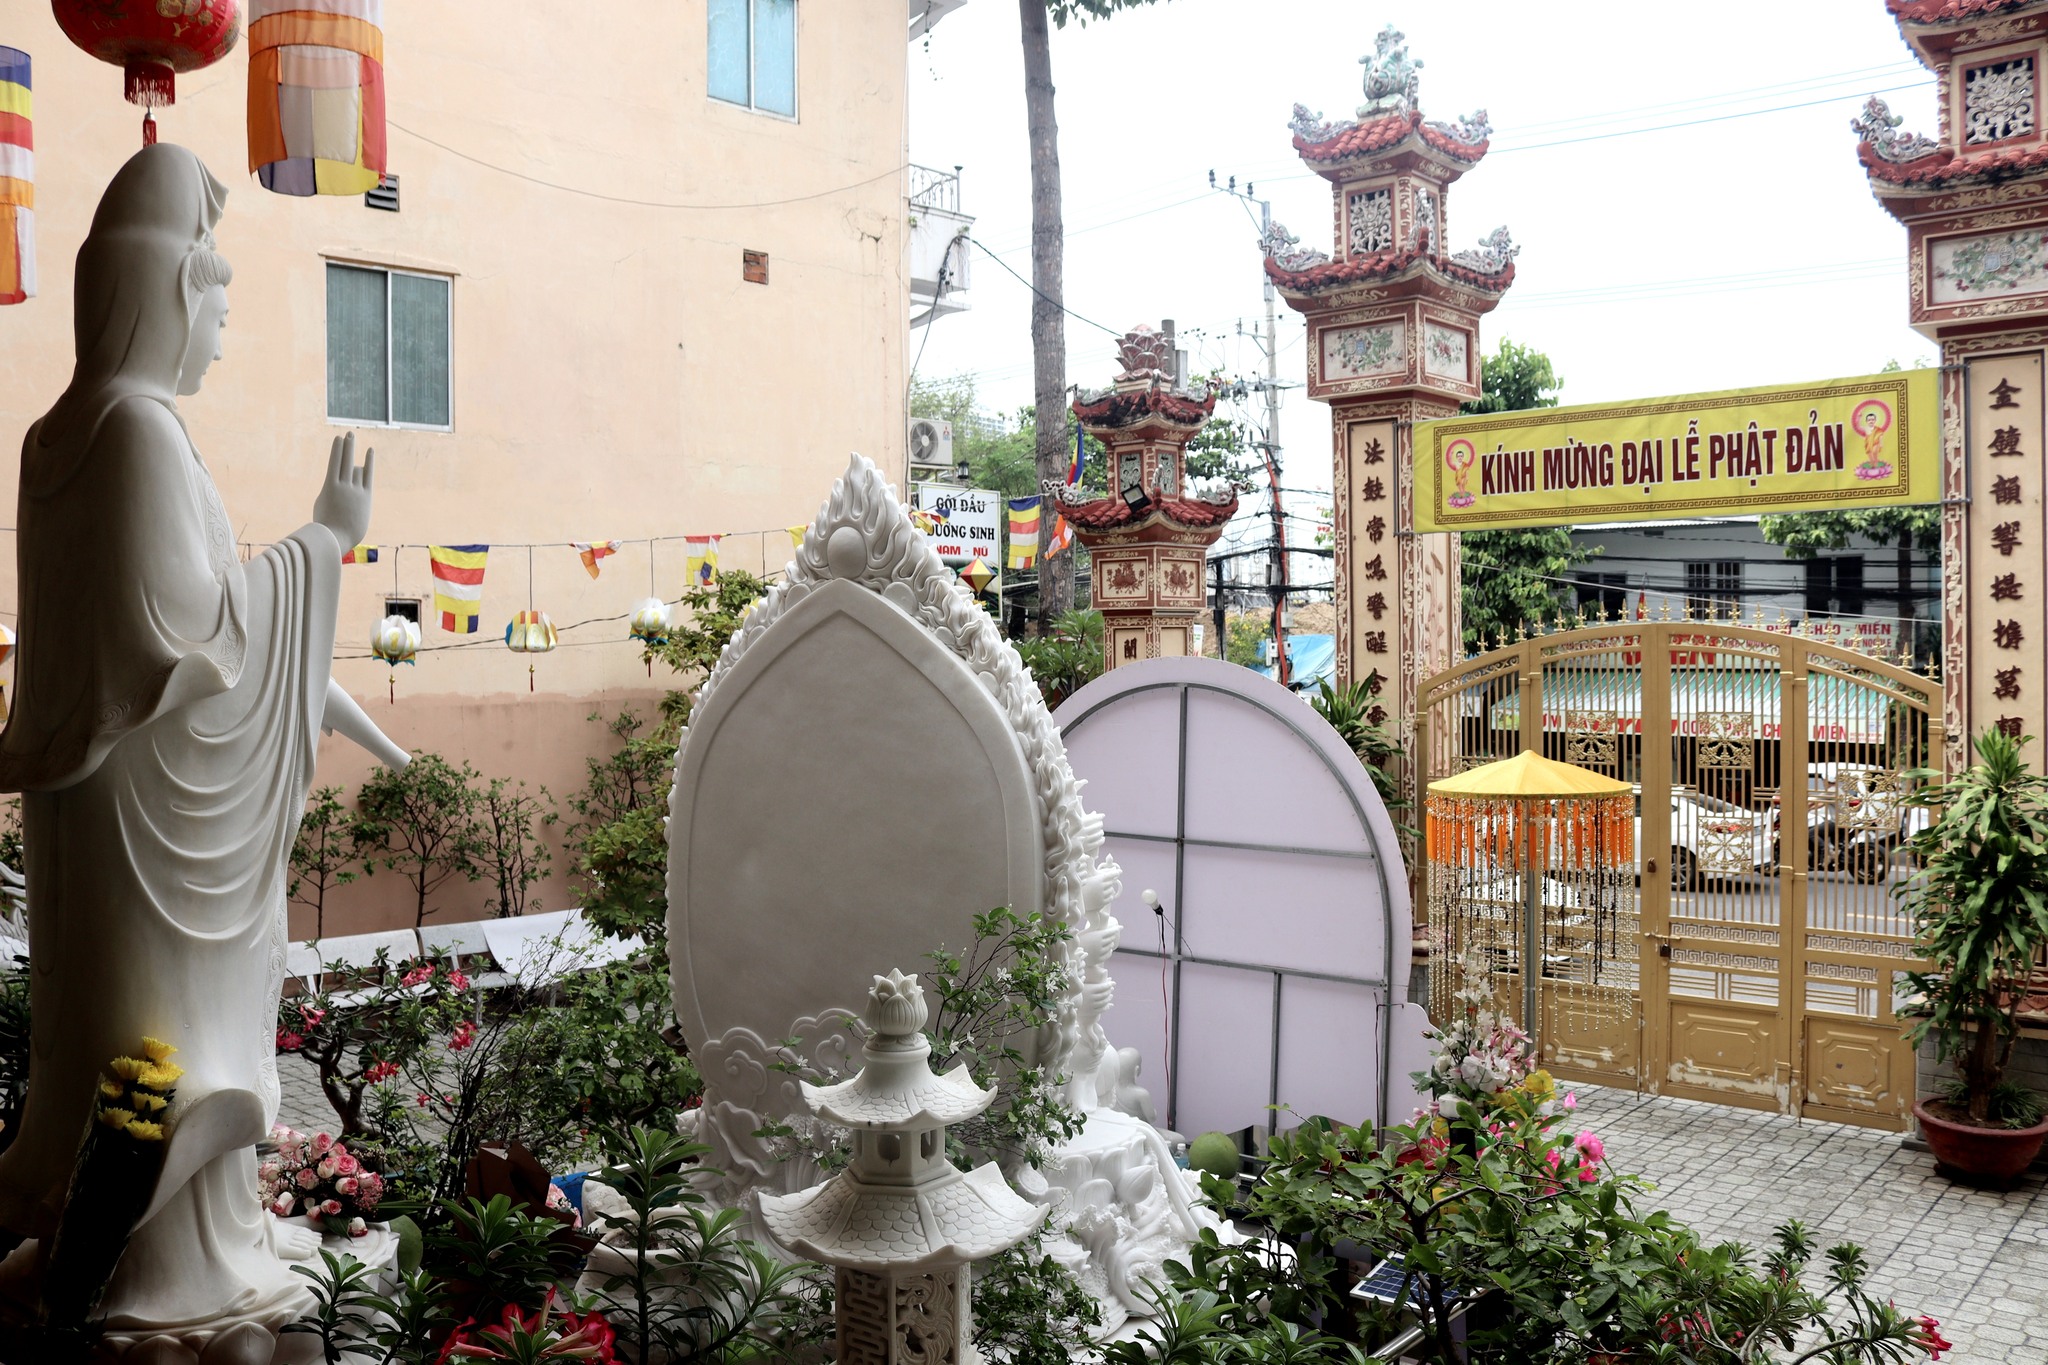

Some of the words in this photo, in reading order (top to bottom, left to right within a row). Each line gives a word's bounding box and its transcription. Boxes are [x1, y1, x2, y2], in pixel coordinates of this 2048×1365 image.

[1481, 444, 1535, 495] KÍNH
[1543, 438, 1614, 491] MỪNG
[1621, 440, 1662, 494] ĐẠI
[1672, 420, 1700, 481] LỄ
[1710, 421, 1777, 487] PHẬT
[1786, 410, 1844, 473] ĐẢN
[970, 526, 995, 540] SINH
[937, 545, 961, 555] NAM
